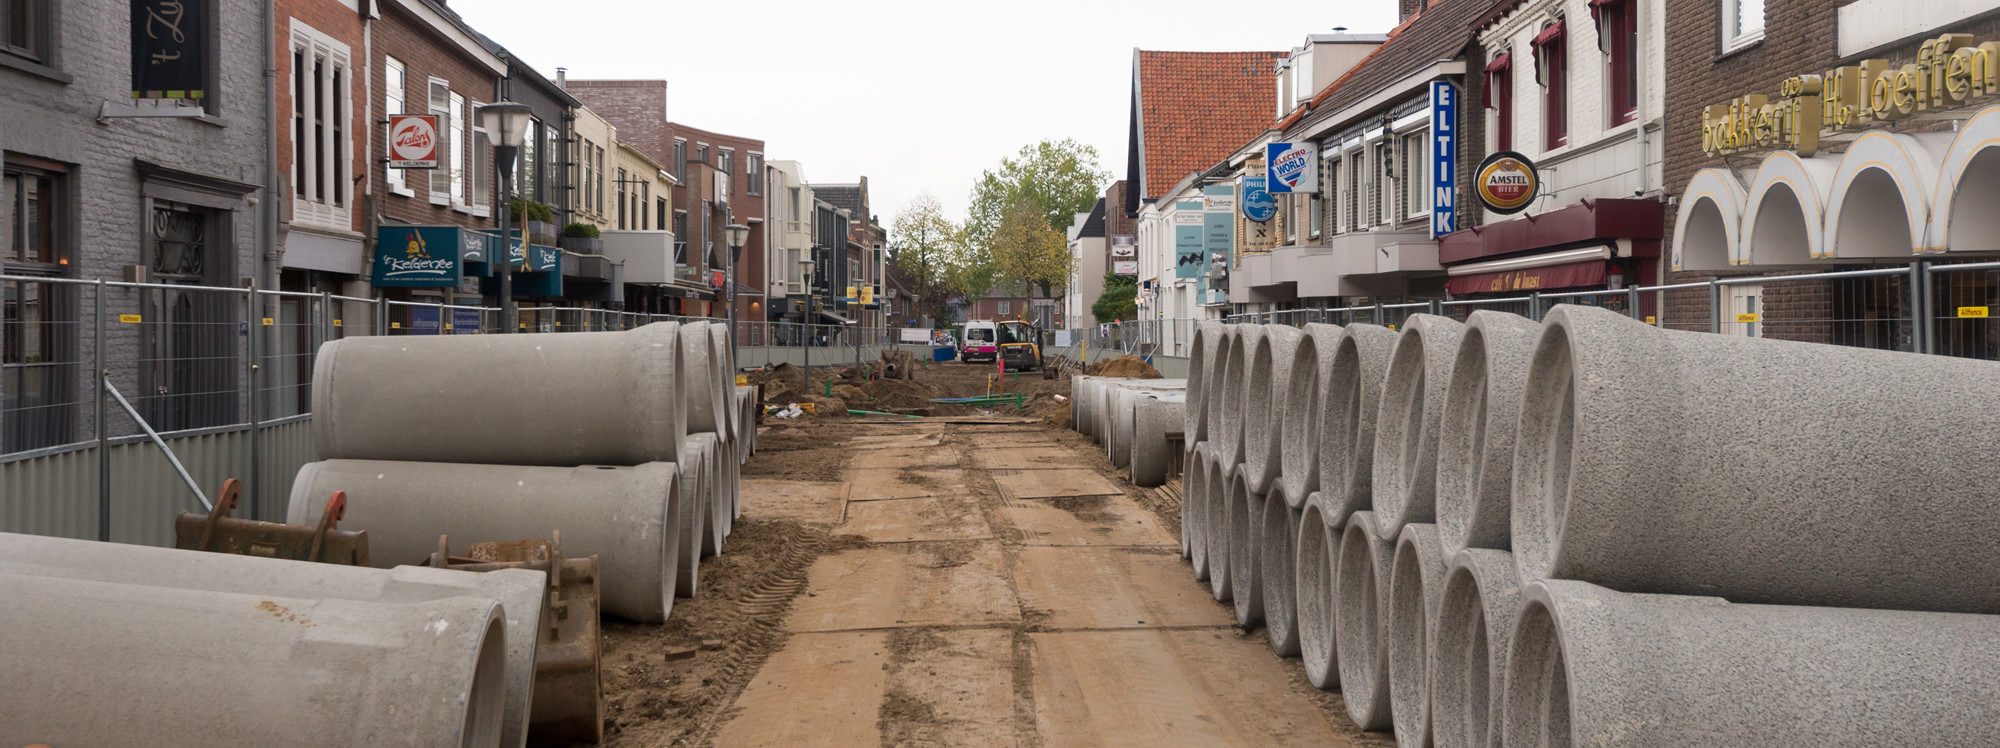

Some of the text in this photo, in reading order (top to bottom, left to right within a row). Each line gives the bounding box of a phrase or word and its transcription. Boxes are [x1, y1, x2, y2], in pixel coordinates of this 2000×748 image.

[145, 0, 185, 44] Zu
[1702, 77, 1808, 157] bakkerij
[1274, 149, 1306, 165] ELECTRO
[1277, 157, 1305, 174] WORLD
[1436, 84, 1452, 233] ELTINK
[1490, 175, 1527, 184] AMSTEL
